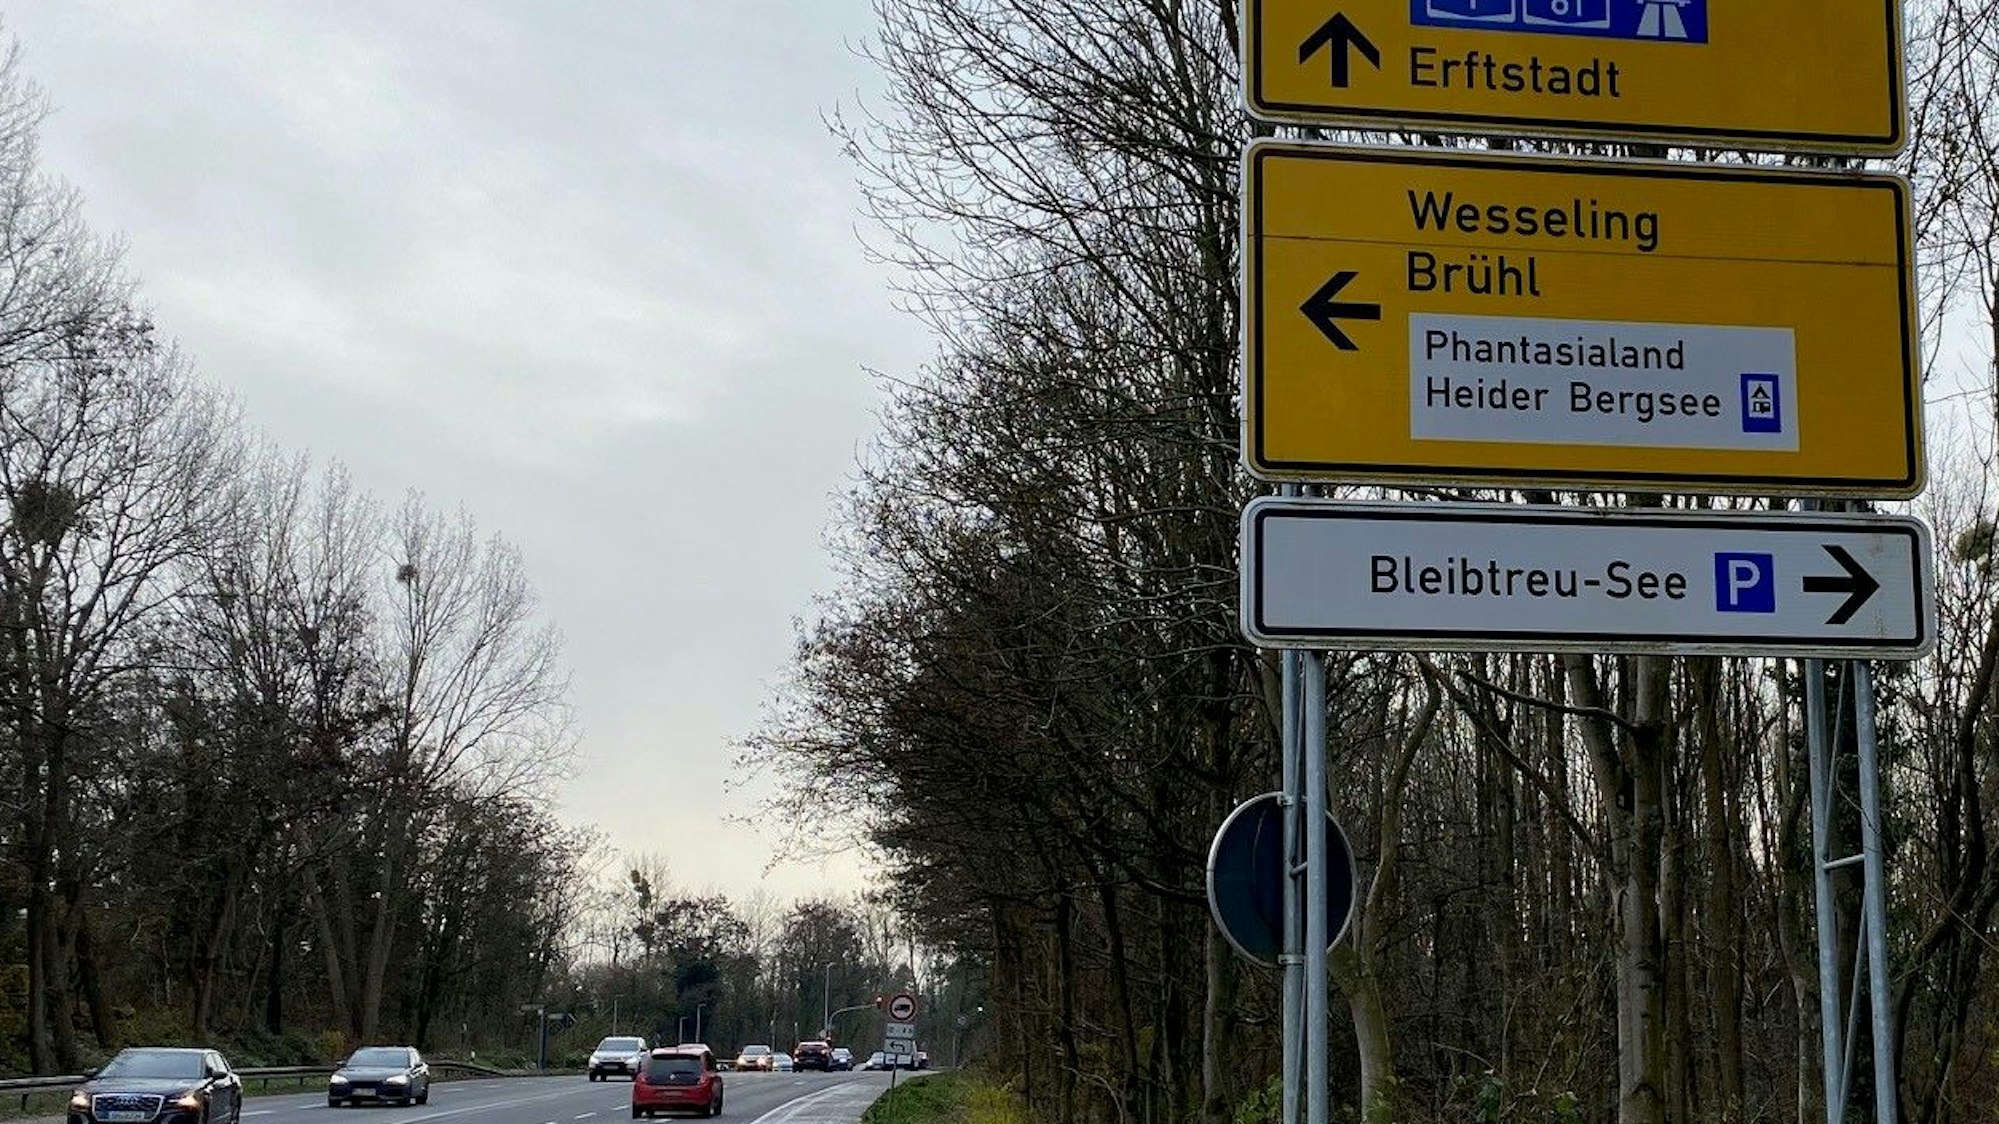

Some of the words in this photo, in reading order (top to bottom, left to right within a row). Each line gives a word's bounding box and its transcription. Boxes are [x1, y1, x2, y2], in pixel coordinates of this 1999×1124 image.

[1410, 46, 1620, 98] Erftstadt
[1407, 190, 1658, 253] Wesseling
[1408, 250, 1540, 297] Brühl
[1426, 330, 1684, 370] Phantasialand
[1427, 376, 1549, 411] Heider
[1570, 381, 1721, 424] Bergsee
[1371, 555, 1687, 600] Bleibtreu-See
[1729, 560, 1761, 605] P
